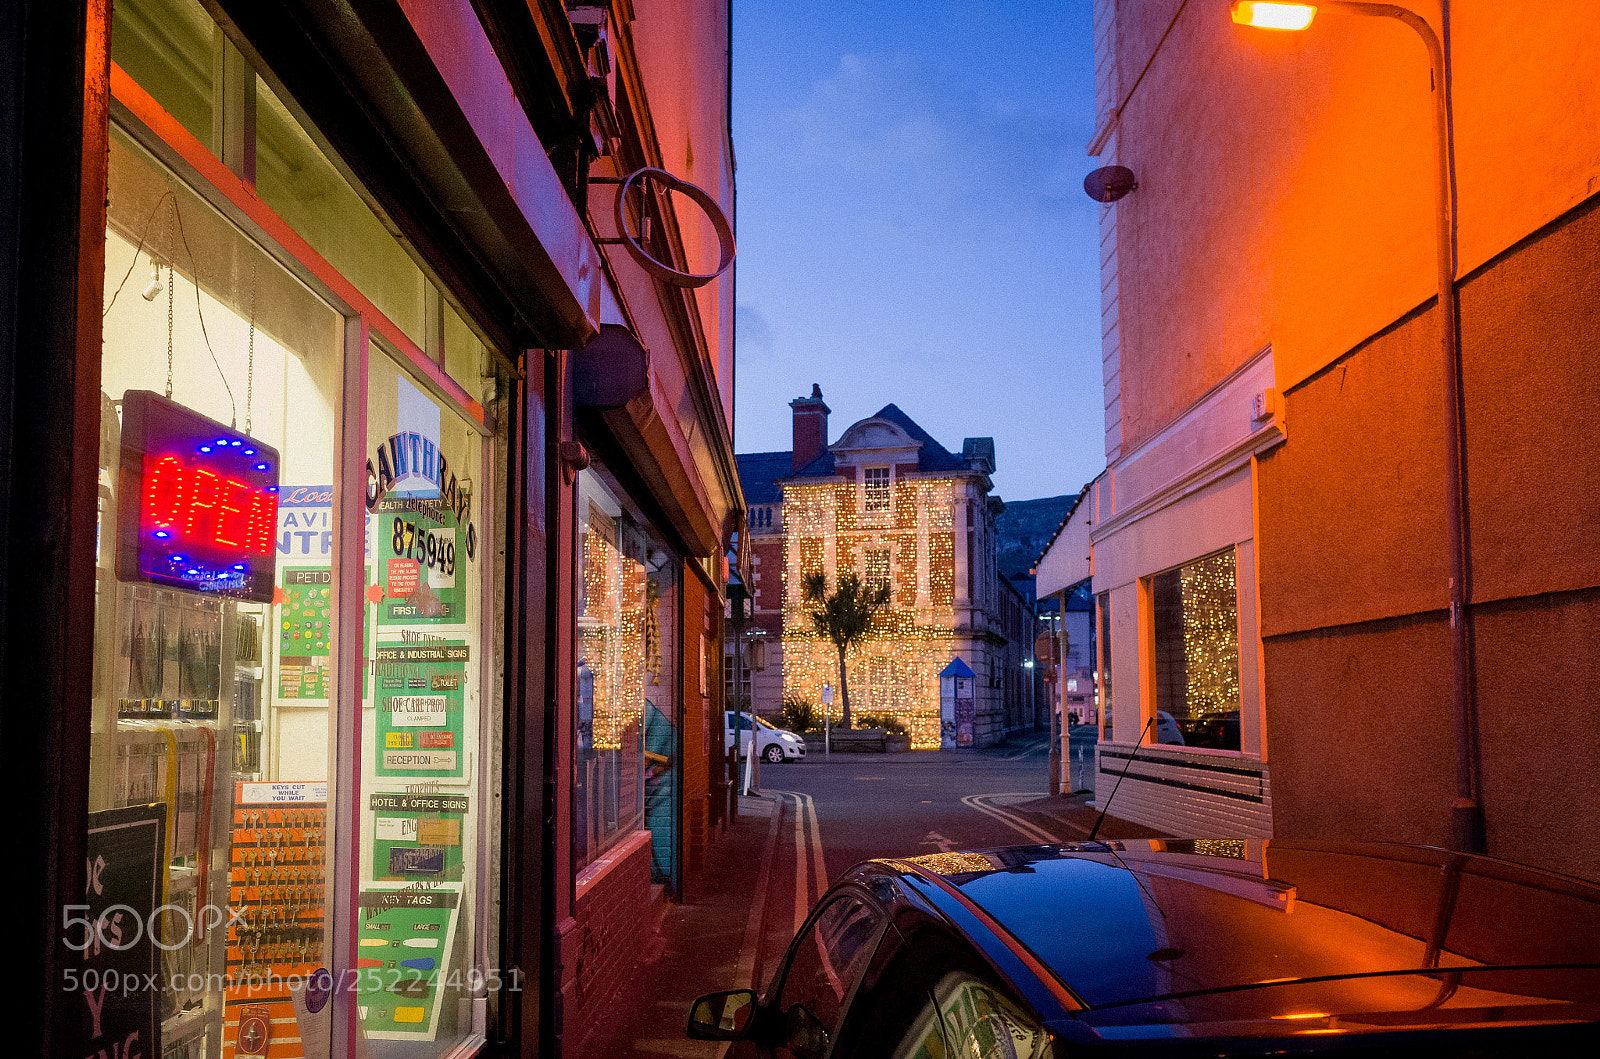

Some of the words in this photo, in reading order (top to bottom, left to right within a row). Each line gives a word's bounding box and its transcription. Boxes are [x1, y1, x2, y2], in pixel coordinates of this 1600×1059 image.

[148, 456, 276, 554] OPEN
[379, 500, 403, 510] EALTH
[283, 511, 328, 528] AVI
[392, 516, 456, 576] 875949
[296, 572, 320, 583] PET
[393, 606, 416, 615] FIRST
[401, 629, 421, 646] SHOE
[377, 650, 397, 660] OFFICE
[399, 650, 405, 659] &
[407, 650, 444, 659] INDUSTRIAL
[447, 649, 467, 658] SIGNS
[382, 696, 404, 713] SHOE
[405, 697, 424, 713] CARE
[386, 755, 431, 765] RECEPTION
[371, 798, 398, 807] HOTEL
[401, 799, 407, 808] &
[410, 800, 439, 809] OFFICE
[442, 801, 467, 809] SIGNS
[382, 895, 403, 905] KEY
[407, 895, 433, 905] TAGS
[413, 923, 430, 931] LARGE
